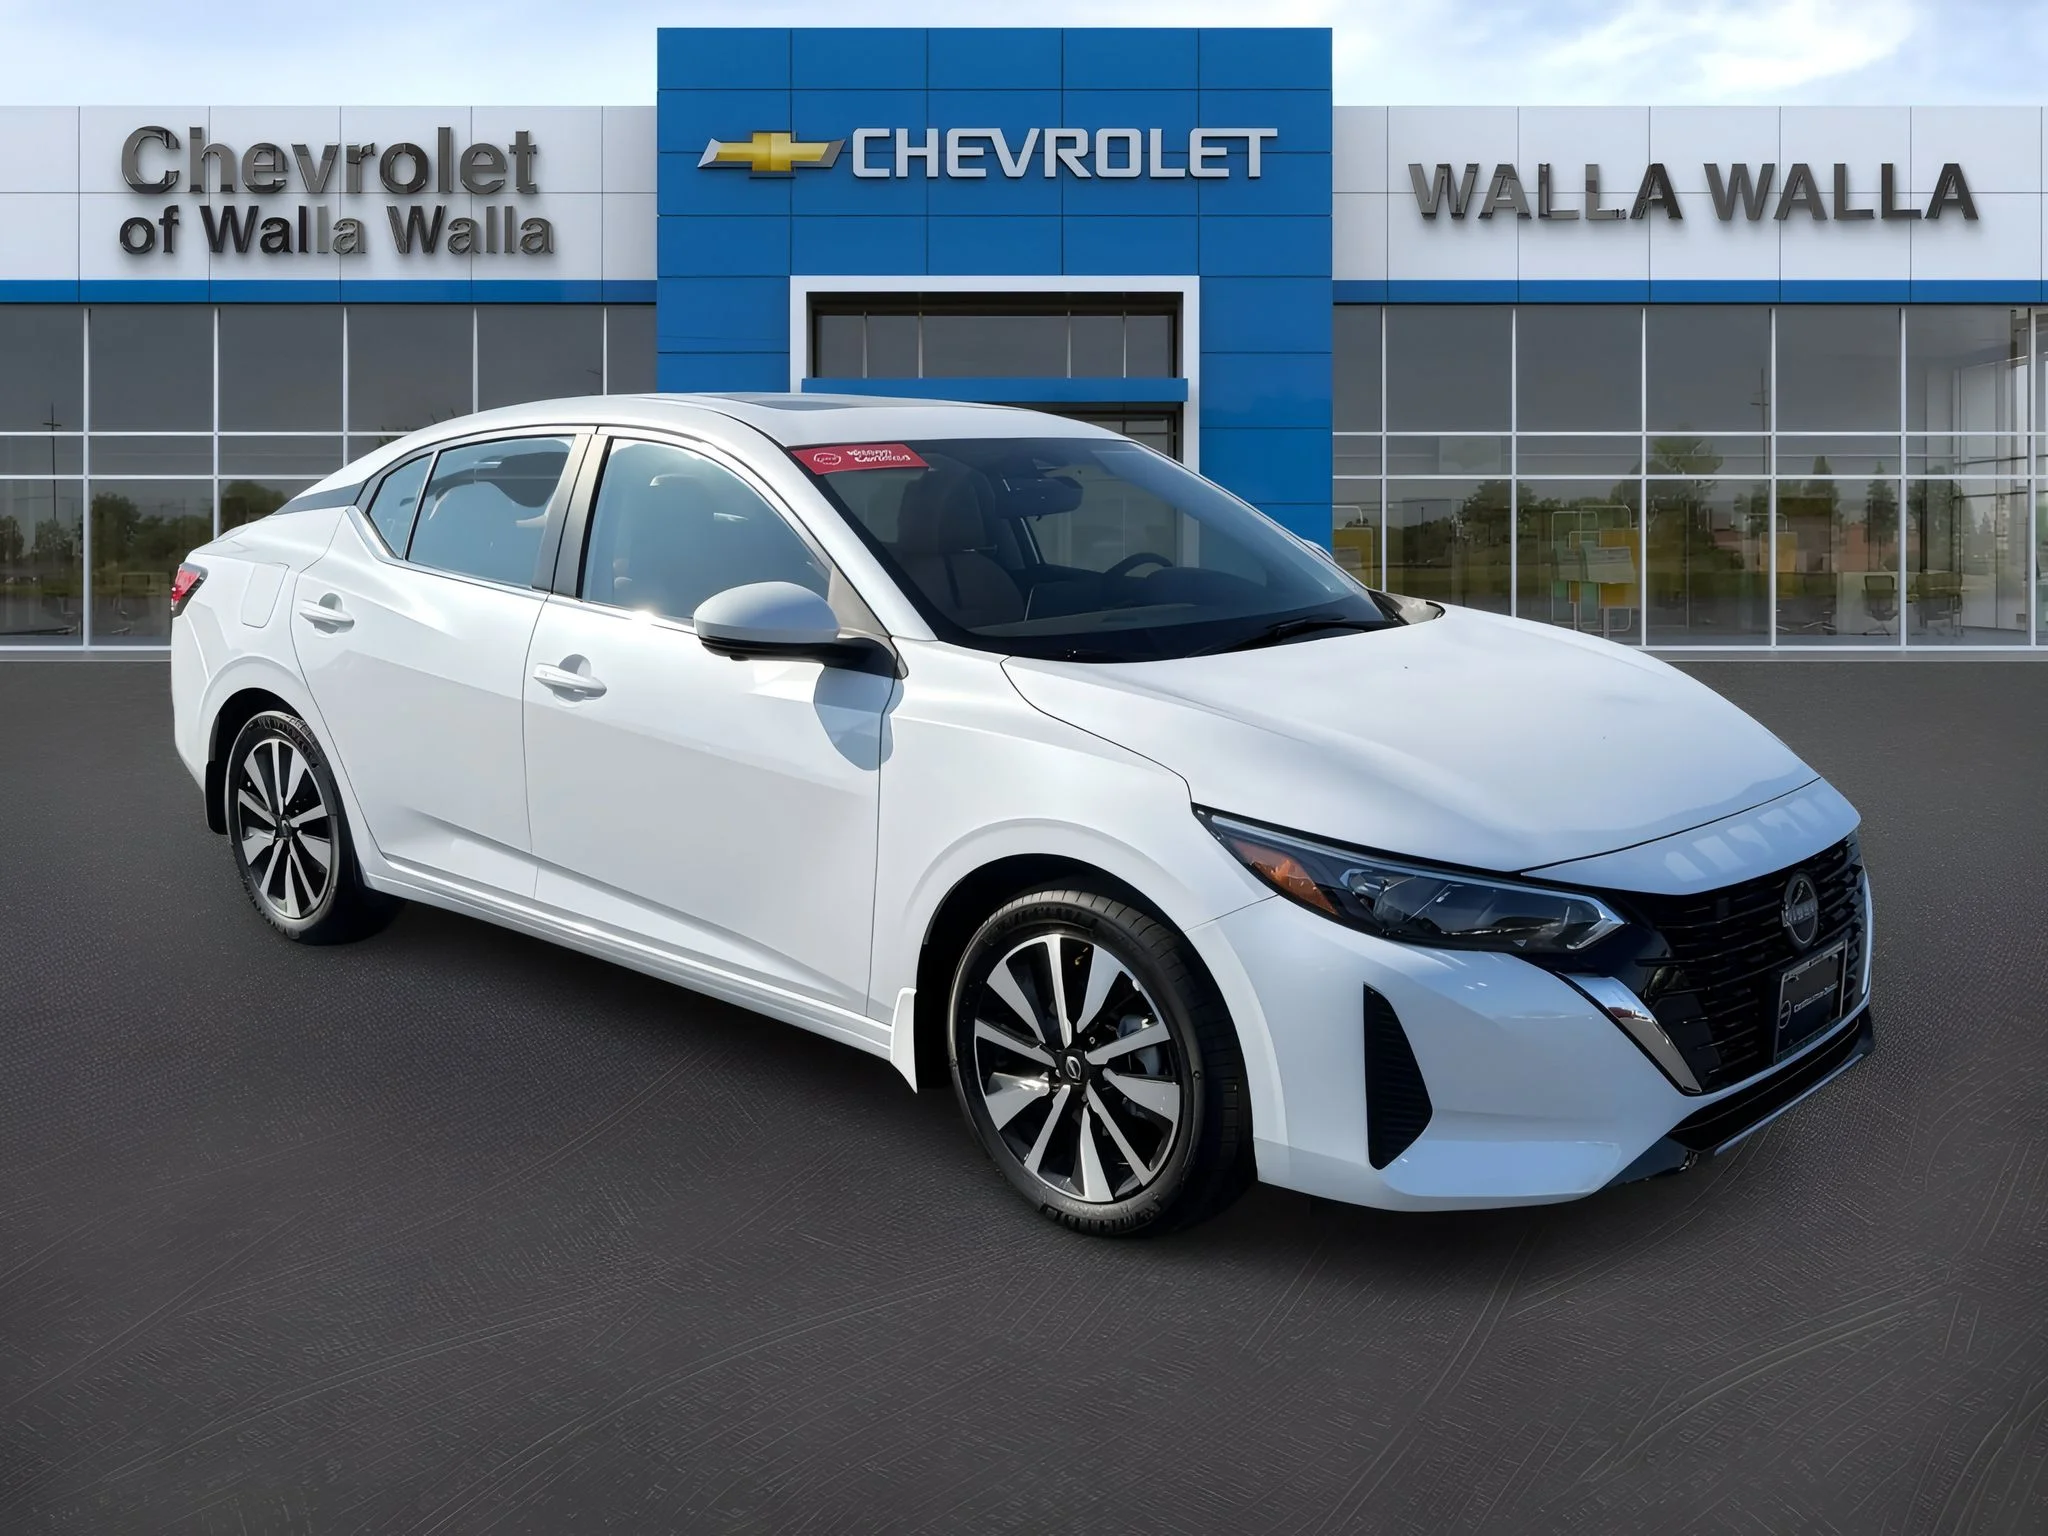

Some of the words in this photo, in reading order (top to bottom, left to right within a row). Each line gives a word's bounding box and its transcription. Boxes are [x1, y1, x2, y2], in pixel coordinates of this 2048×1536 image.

[121, 125, 537, 194] Chevrolet
[852, 127, 1278, 179] CHEVROLET
[1408, 163, 1684, 220] WALLA
[1703, 163, 1979, 220] WALLA
[119, 205, 180, 254] of
[200, 205, 367, 254] Walla
[386, 205, 554, 254] Walla
